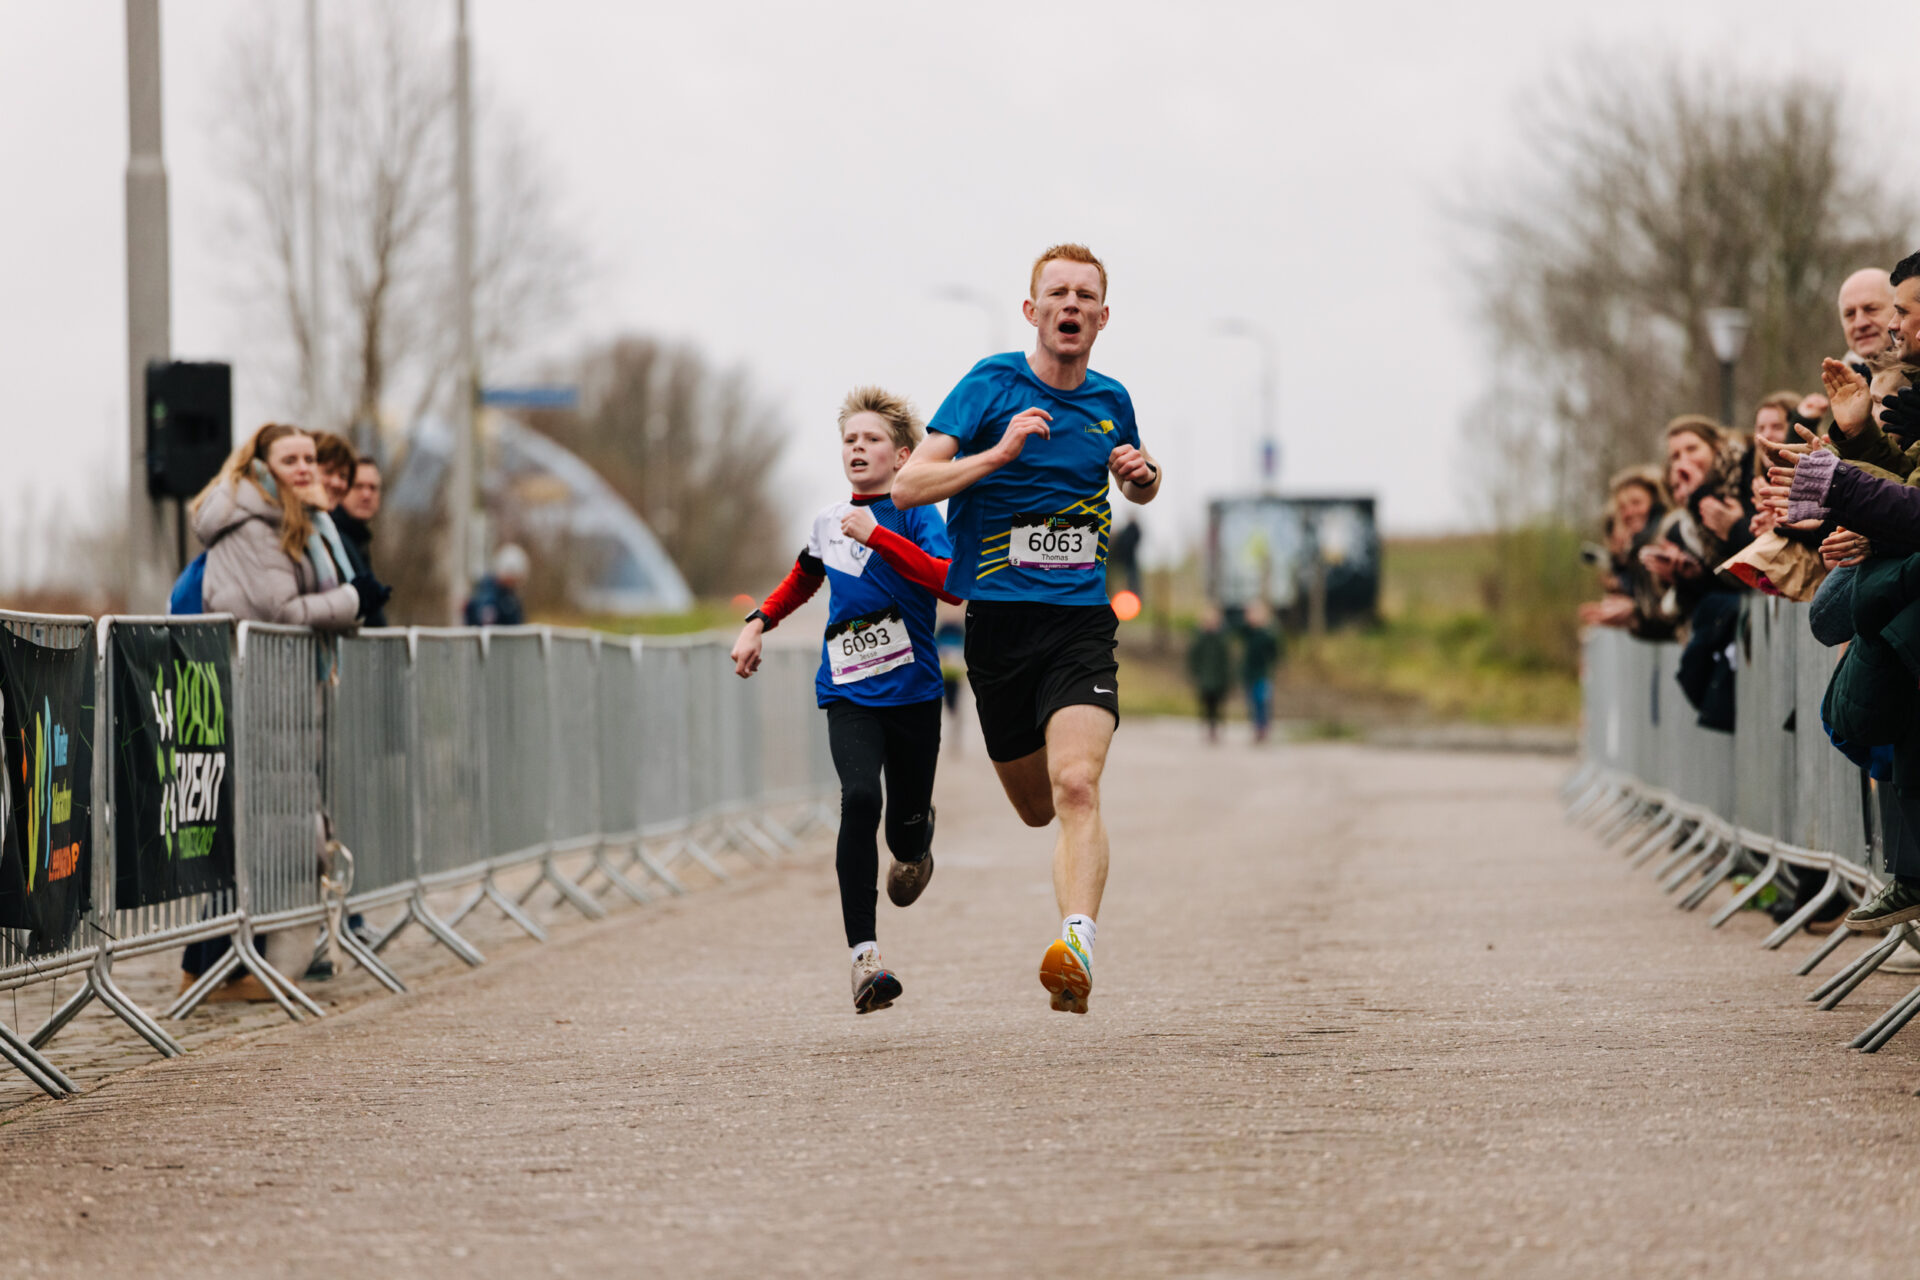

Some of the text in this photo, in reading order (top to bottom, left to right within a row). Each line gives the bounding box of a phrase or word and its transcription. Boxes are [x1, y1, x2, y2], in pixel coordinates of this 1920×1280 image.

[1028, 532, 1083, 553] 6063
[1041, 553, 1069, 562] Thomas
[842, 628, 891, 656] 6093
